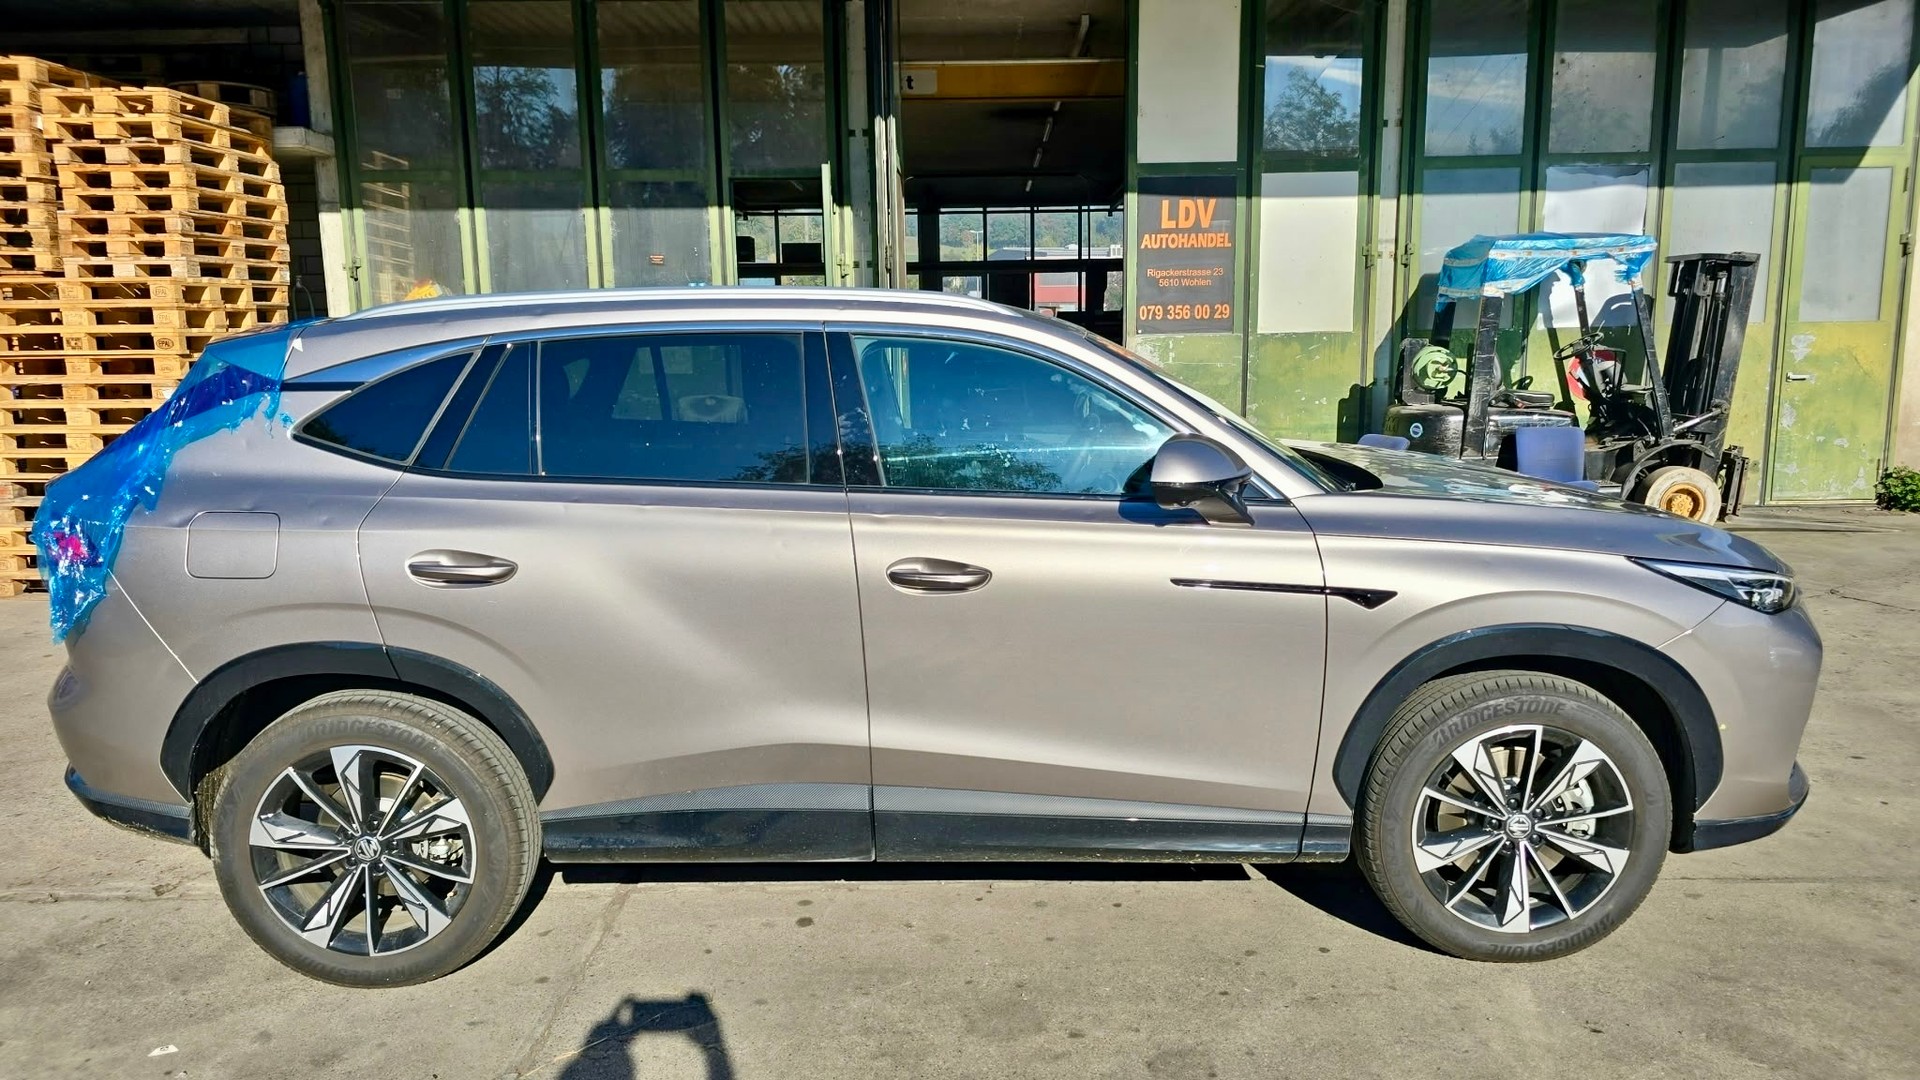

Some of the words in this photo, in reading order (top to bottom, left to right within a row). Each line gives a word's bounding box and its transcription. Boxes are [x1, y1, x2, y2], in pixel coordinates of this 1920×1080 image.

[1161, 198, 1217, 229] LDV
[1140, 232, 1232, 249] AUTOHANDEL
[1147, 268, 1212, 279] Rigackerstrasse
[1213, 267, 1224, 276] 23
[1158, 278, 1179, 287] 5610
[1181, 278, 1212, 287] Wohlen
[1139, 305, 1163, 320] 079
[1167, 304, 1191, 320] 356
[1194, 304, 1210, 319] 00
[1214, 303, 1230, 319] 29
[1433, 698, 1566, 749] BRIDGESTONE
